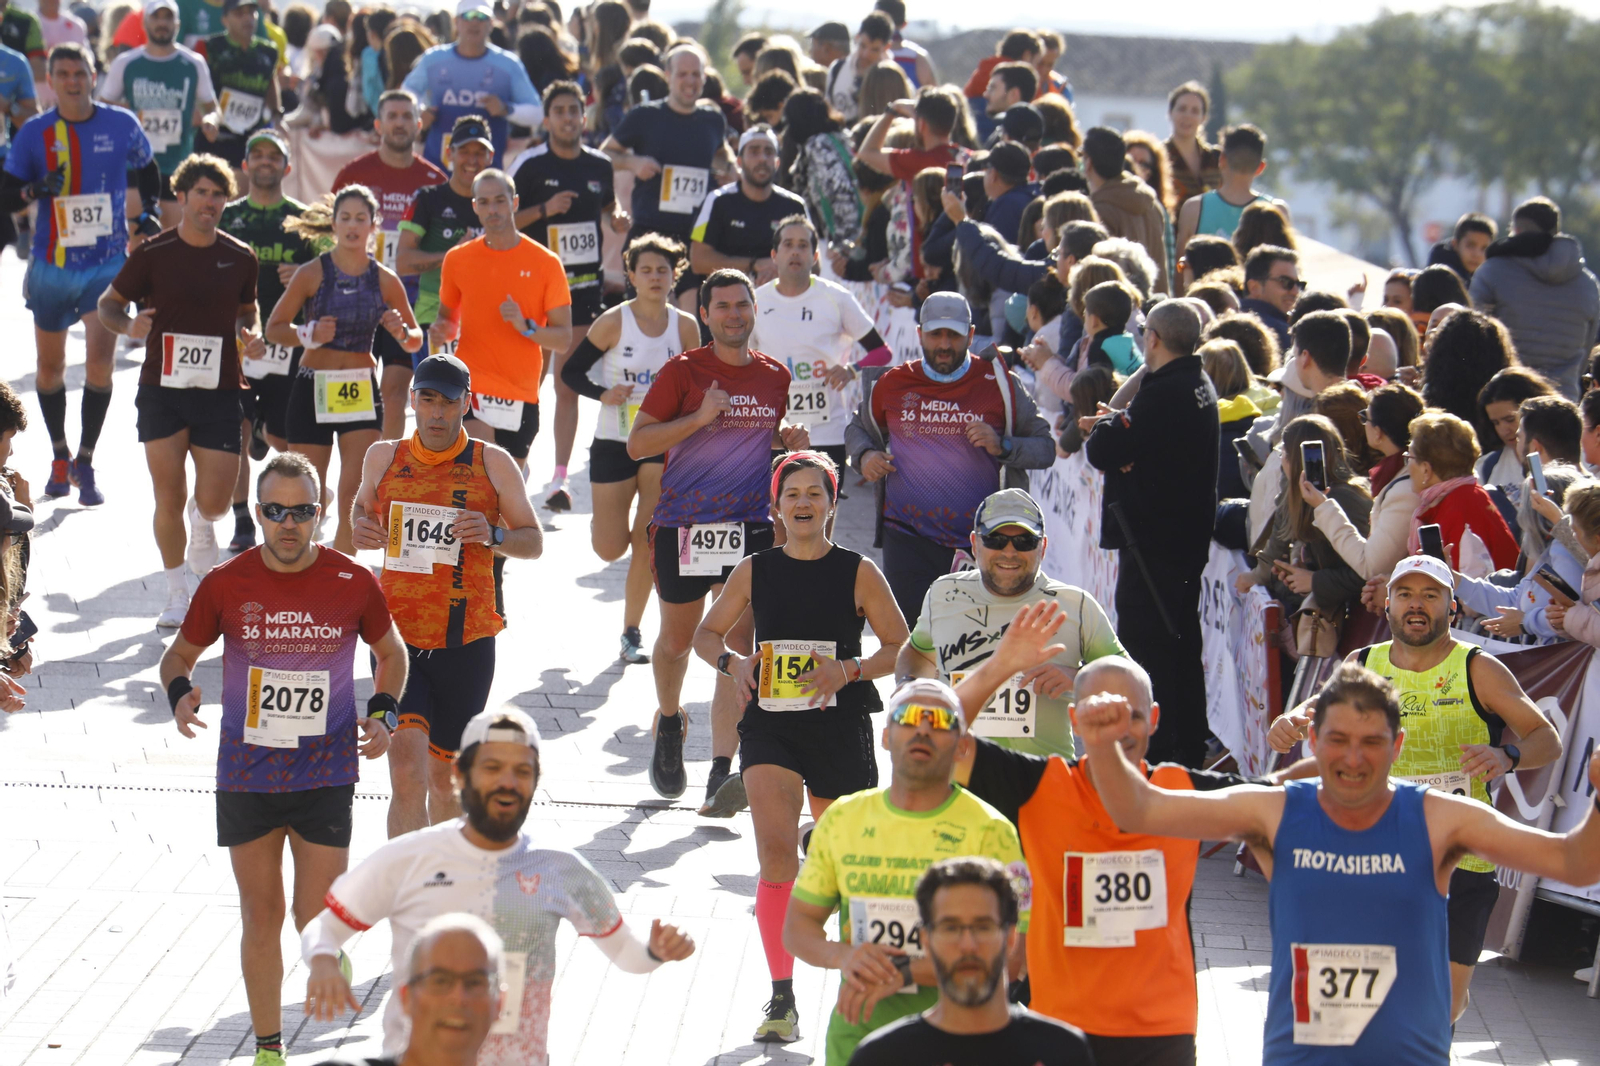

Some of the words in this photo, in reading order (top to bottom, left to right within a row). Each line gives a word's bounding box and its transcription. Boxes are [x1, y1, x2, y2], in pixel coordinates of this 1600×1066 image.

[144, 119, 178, 134] 2347
[673, 176, 704, 194] 1731
[72, 206, 103, 224] 837
[560, 232, 596, 251] 1038
[178, 346, 213, 366] 207
[337, 382, 360, 400] 46
[786, 391, 827, 411] 1218
[920, 400, 960, 412] MEDIA
[900, 409, 917, 422] 36
[919, 410, 984, 423] MARATÓN
[412, 506, 442, 516] IMDECO
[392, 523, 400, 546] CAJÓN
[404, 518, 457, 546] 1649
[691, 529, 742, 550] 4976
[265, 611, 314, 625] MEDIA
[241, 624, 260, 640] 36
[265, 622, 343, 640] MARATÓN
[781, 643, 811, 651] IMDECO
[271, 672, 304, 682] IMDECO
[763, 663, 771, 686] CAJÓN
[251, 689, 259, 715] CAJÓN
[260, 684, 325, 714] 2078
[840, 854, 882, 867] CLUB
[1095, 855, 1133, 865] IMDECO
[1292, 848, 1407, 875] TROTASIERRA
[1094, 871, 1152, 904] 380
[869, 919, 922, 951] 294
[1320, 949, 1361, 959] IMDECO
[1318, 966, 1380, 999] 377
